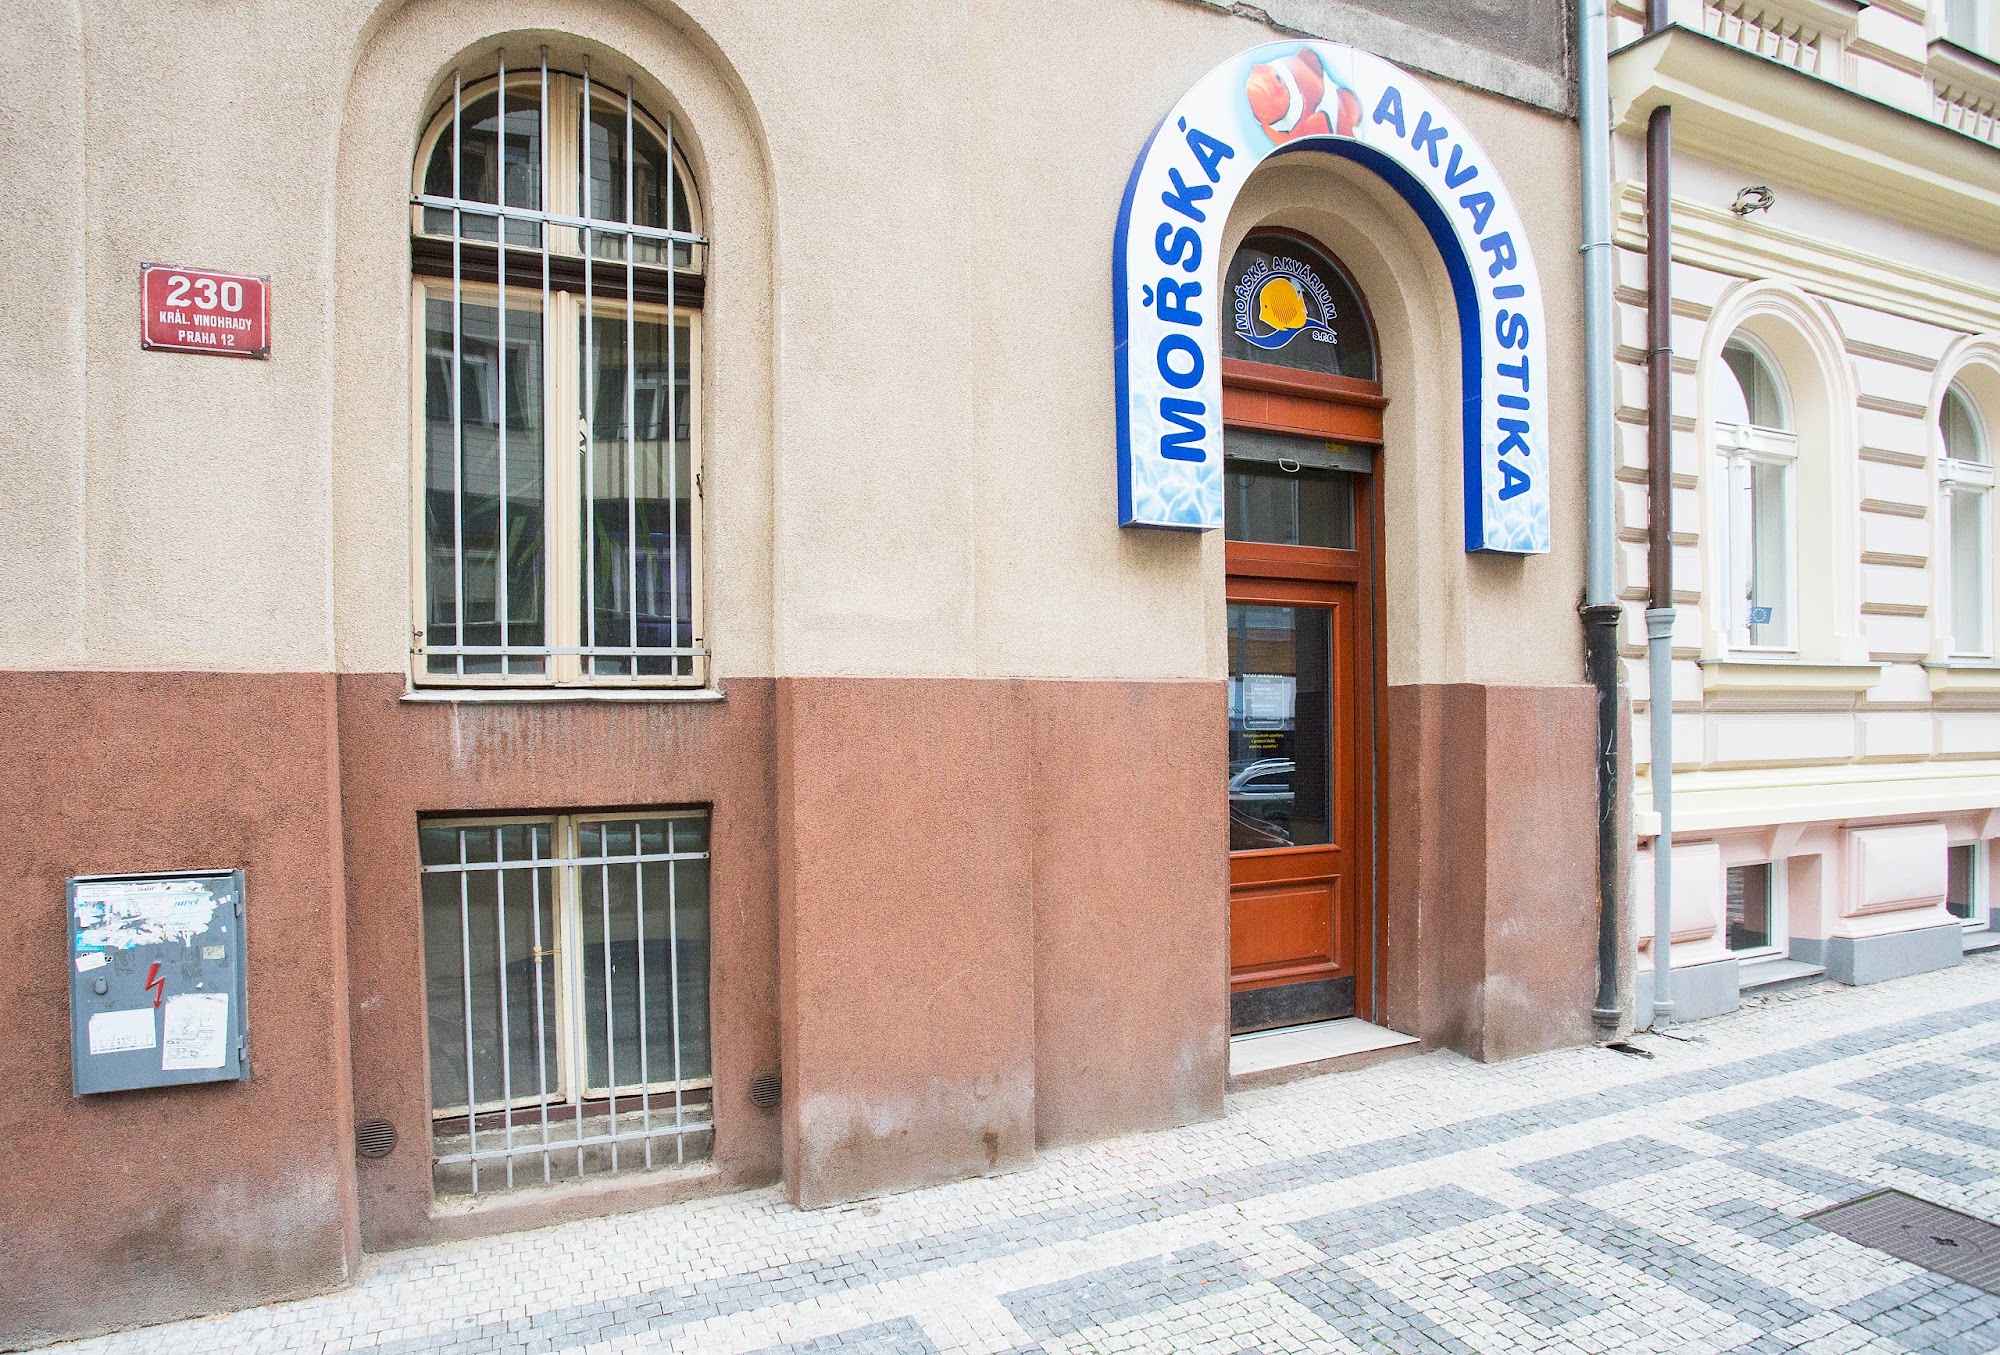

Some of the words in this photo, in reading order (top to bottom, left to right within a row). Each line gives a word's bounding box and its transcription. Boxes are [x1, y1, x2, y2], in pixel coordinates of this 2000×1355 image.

[166, 275, 243, 312] 230
[1143, 116, 1235, 463] MOŘSKÁ
[1373, 86, 1532, 501] AKVARISTIKA
[1234, 258, 1268, 329] MOŘSKÉ
[1272, 257, 1337, 320] AKVÁRIUM
[159, 309, 190, 325] KRÁL.
[193, 314, 252, 331] VINOHRADY
[178, 330, 217, 345] PRAHA
[221, 333, 235, 346] 12
